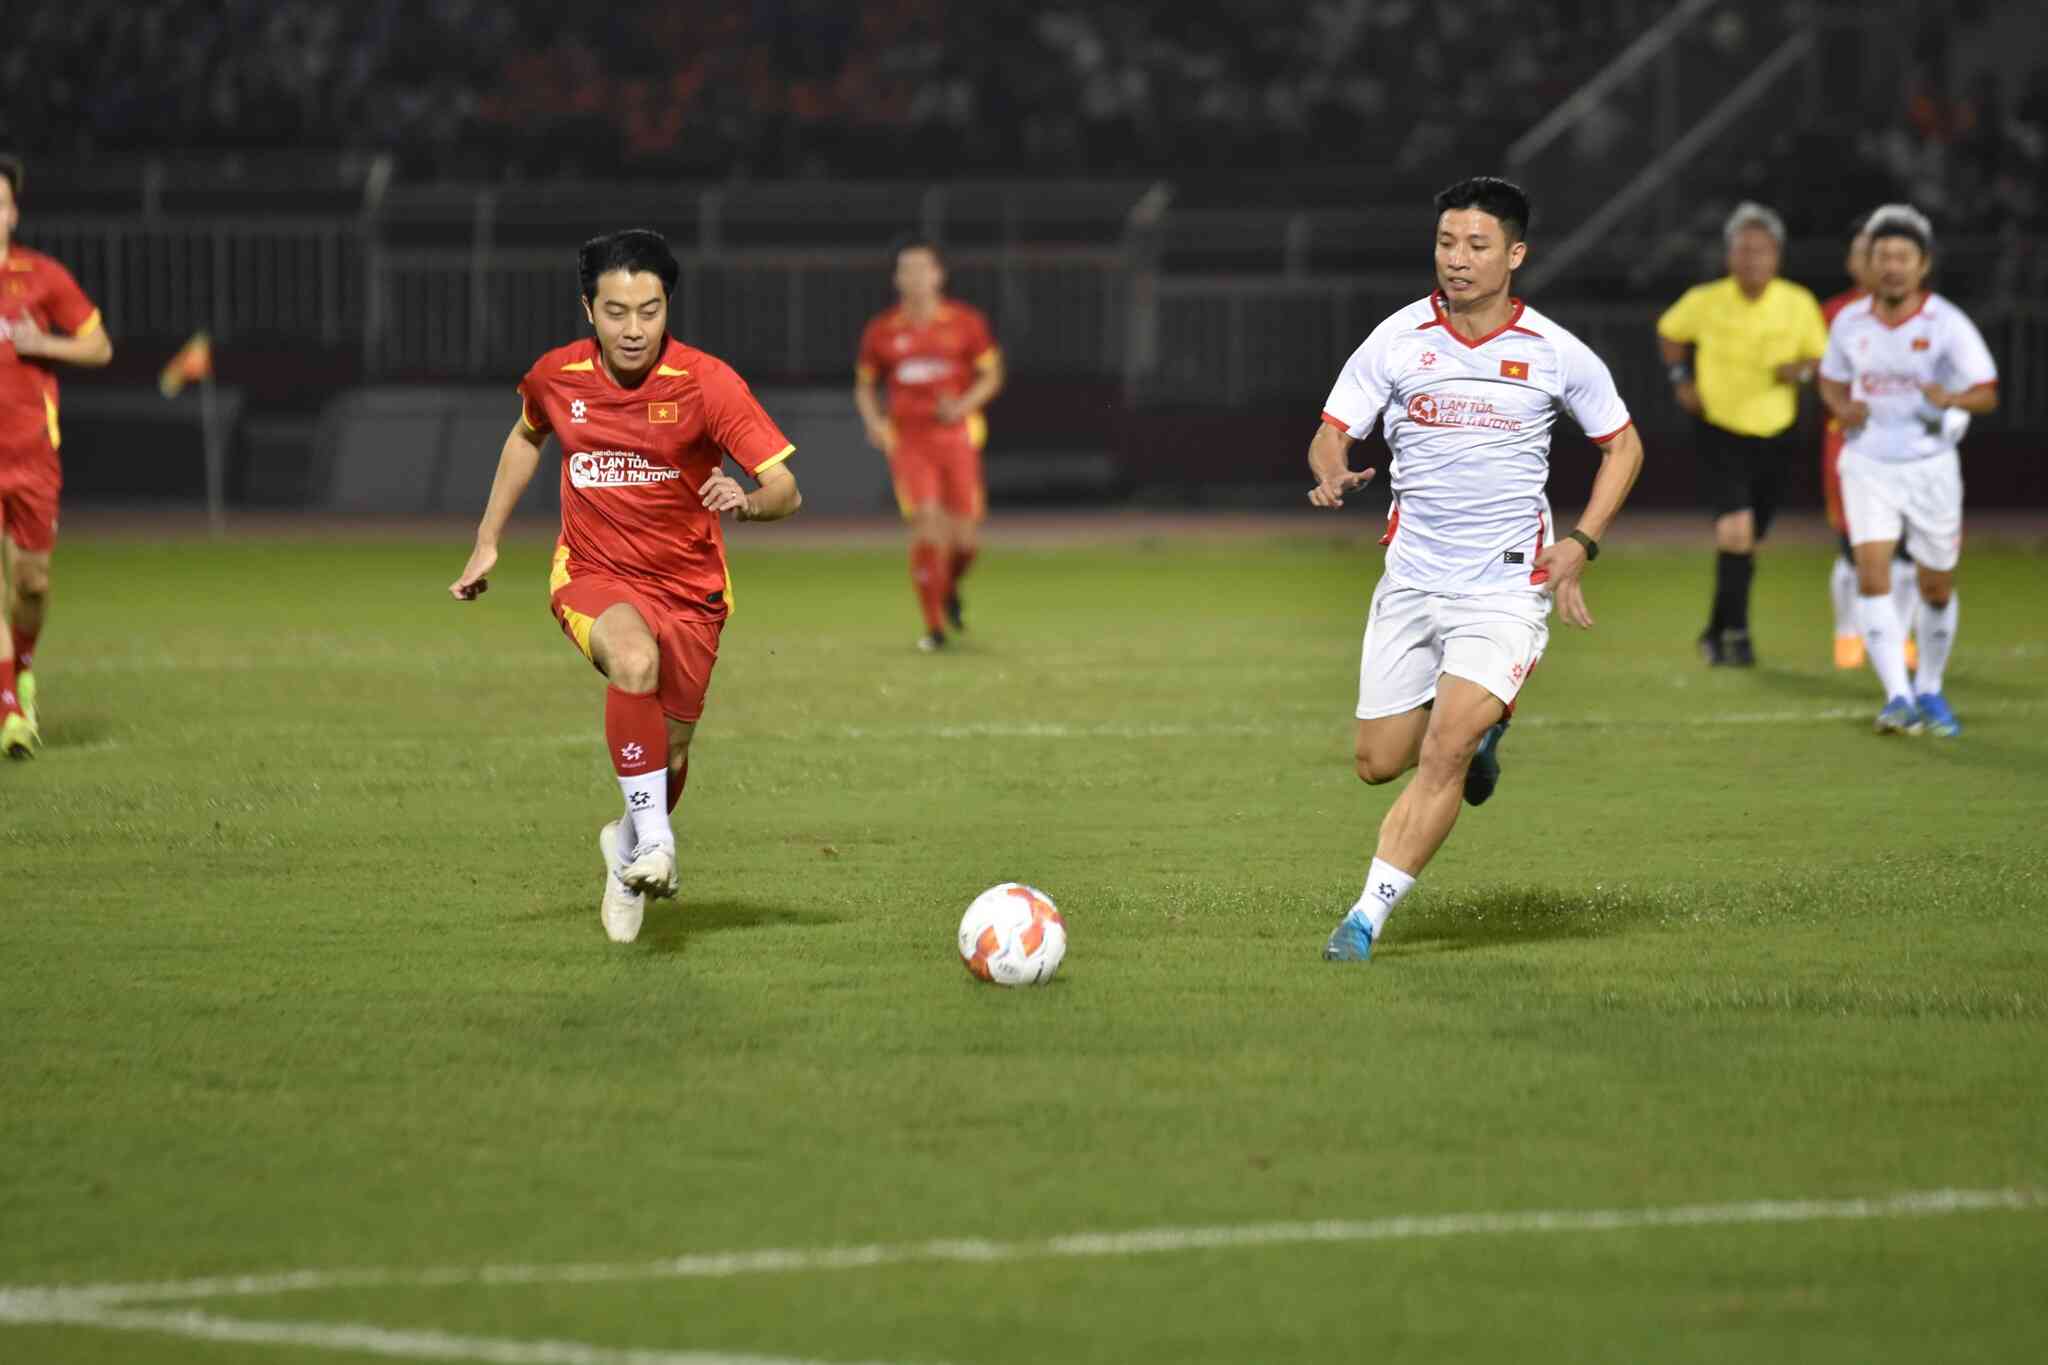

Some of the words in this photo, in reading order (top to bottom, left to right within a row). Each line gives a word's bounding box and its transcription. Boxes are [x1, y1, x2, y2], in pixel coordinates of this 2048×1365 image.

[1440, 400, 1468, 411] LAN
[600, 457, 625, 469] LAN
[627, 455, 651, 469] TỎA
[599, 468, 625, 482] YÊU
[627, 470, 681, 482] THƯƠNG
